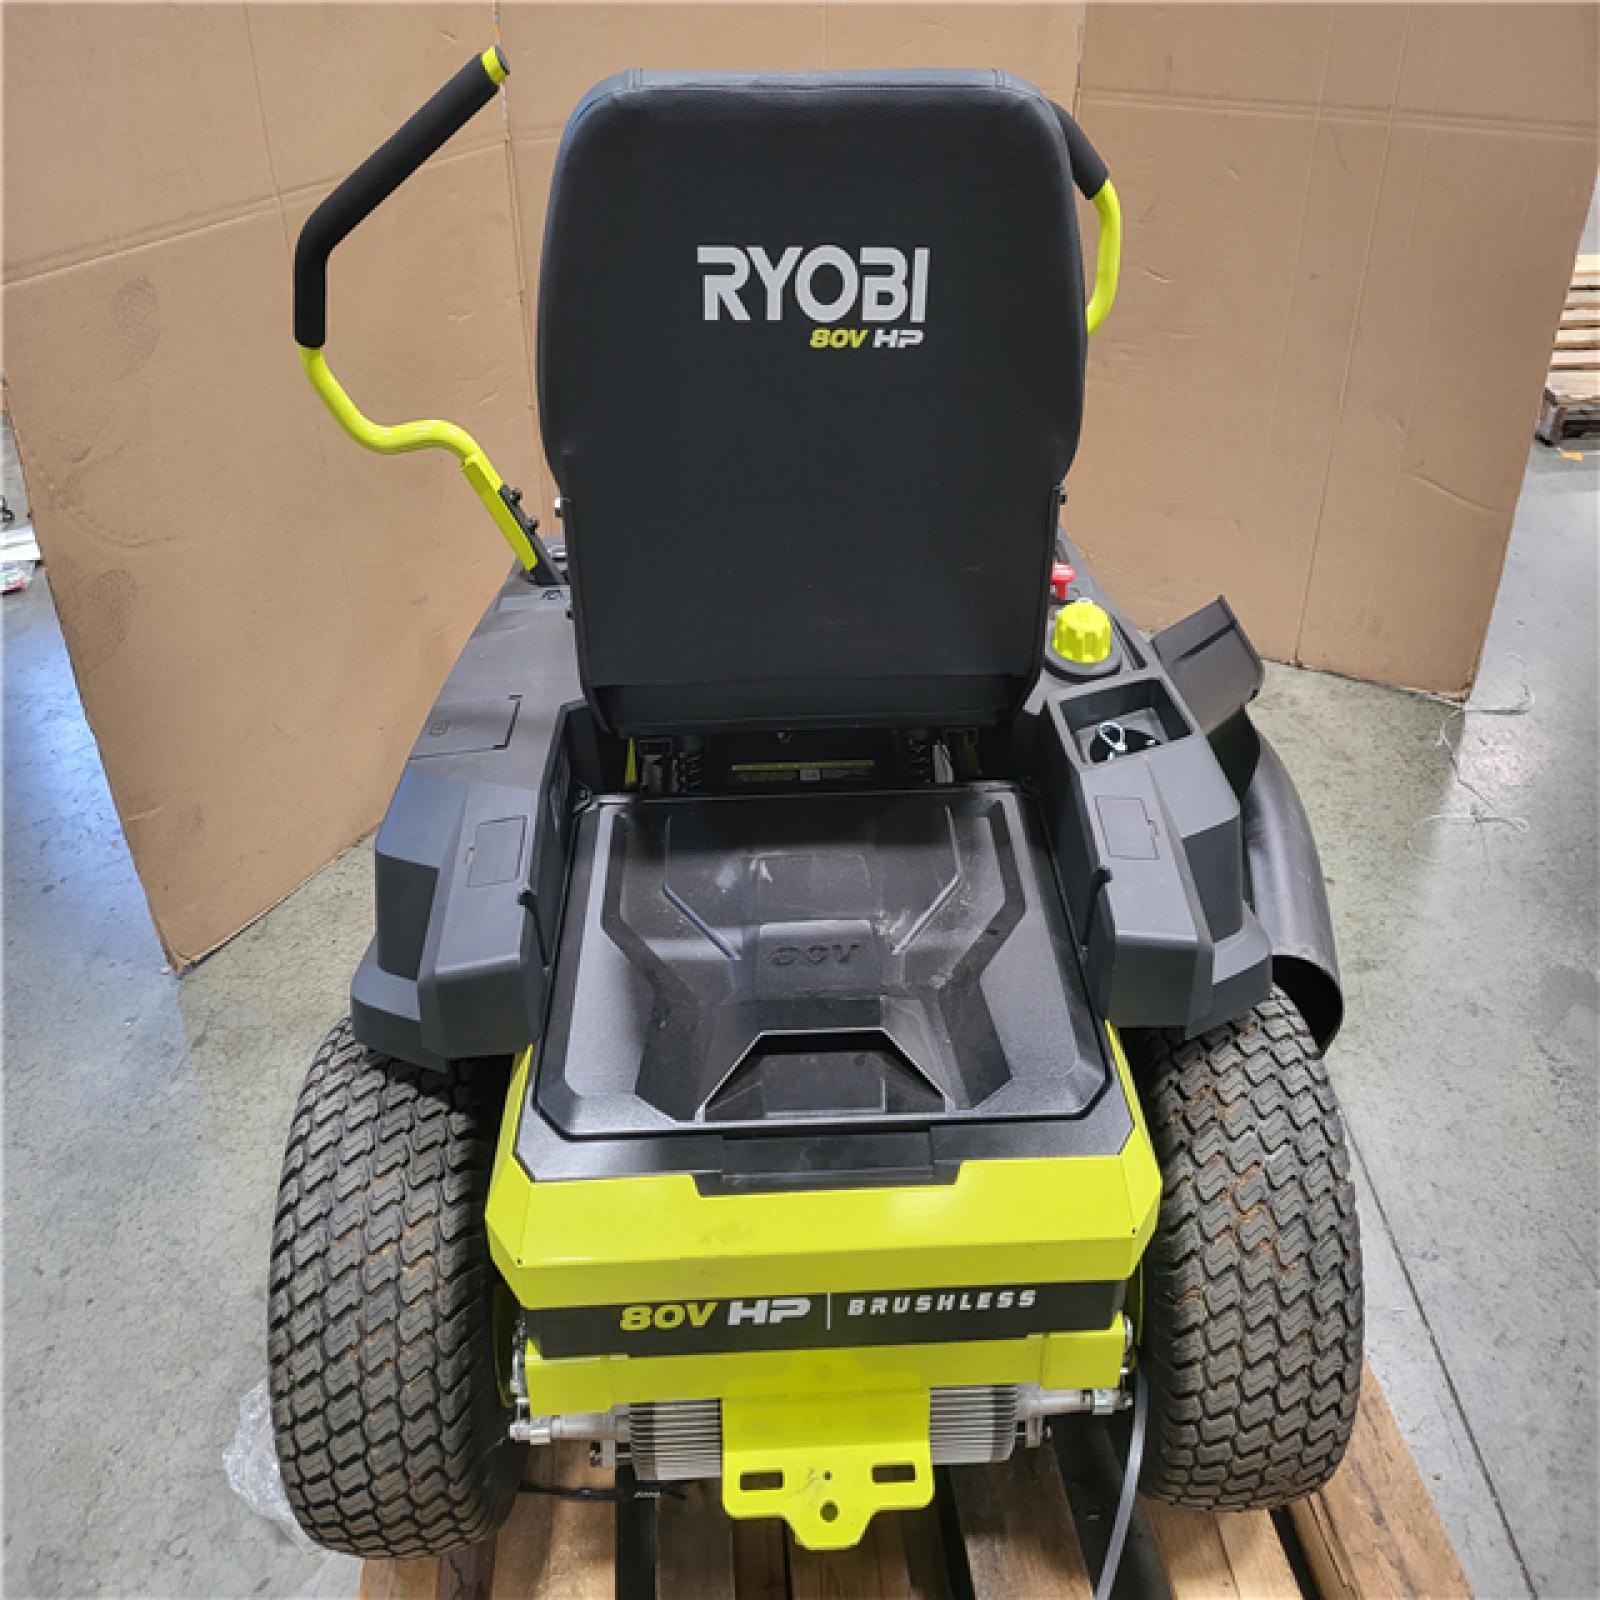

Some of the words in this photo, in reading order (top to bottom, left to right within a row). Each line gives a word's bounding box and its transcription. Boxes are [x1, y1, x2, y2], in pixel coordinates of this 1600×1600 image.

[697, 245, 930, 323] RYOBI
[810, 329, 868, 348] 80V
[873, 329, 924, 348] HP
[620, 1303, 718, 1330] 80V
[727, 1299, 811, 1326] HP
[847, 1290, 1037, 1316] BRUSHLESS
